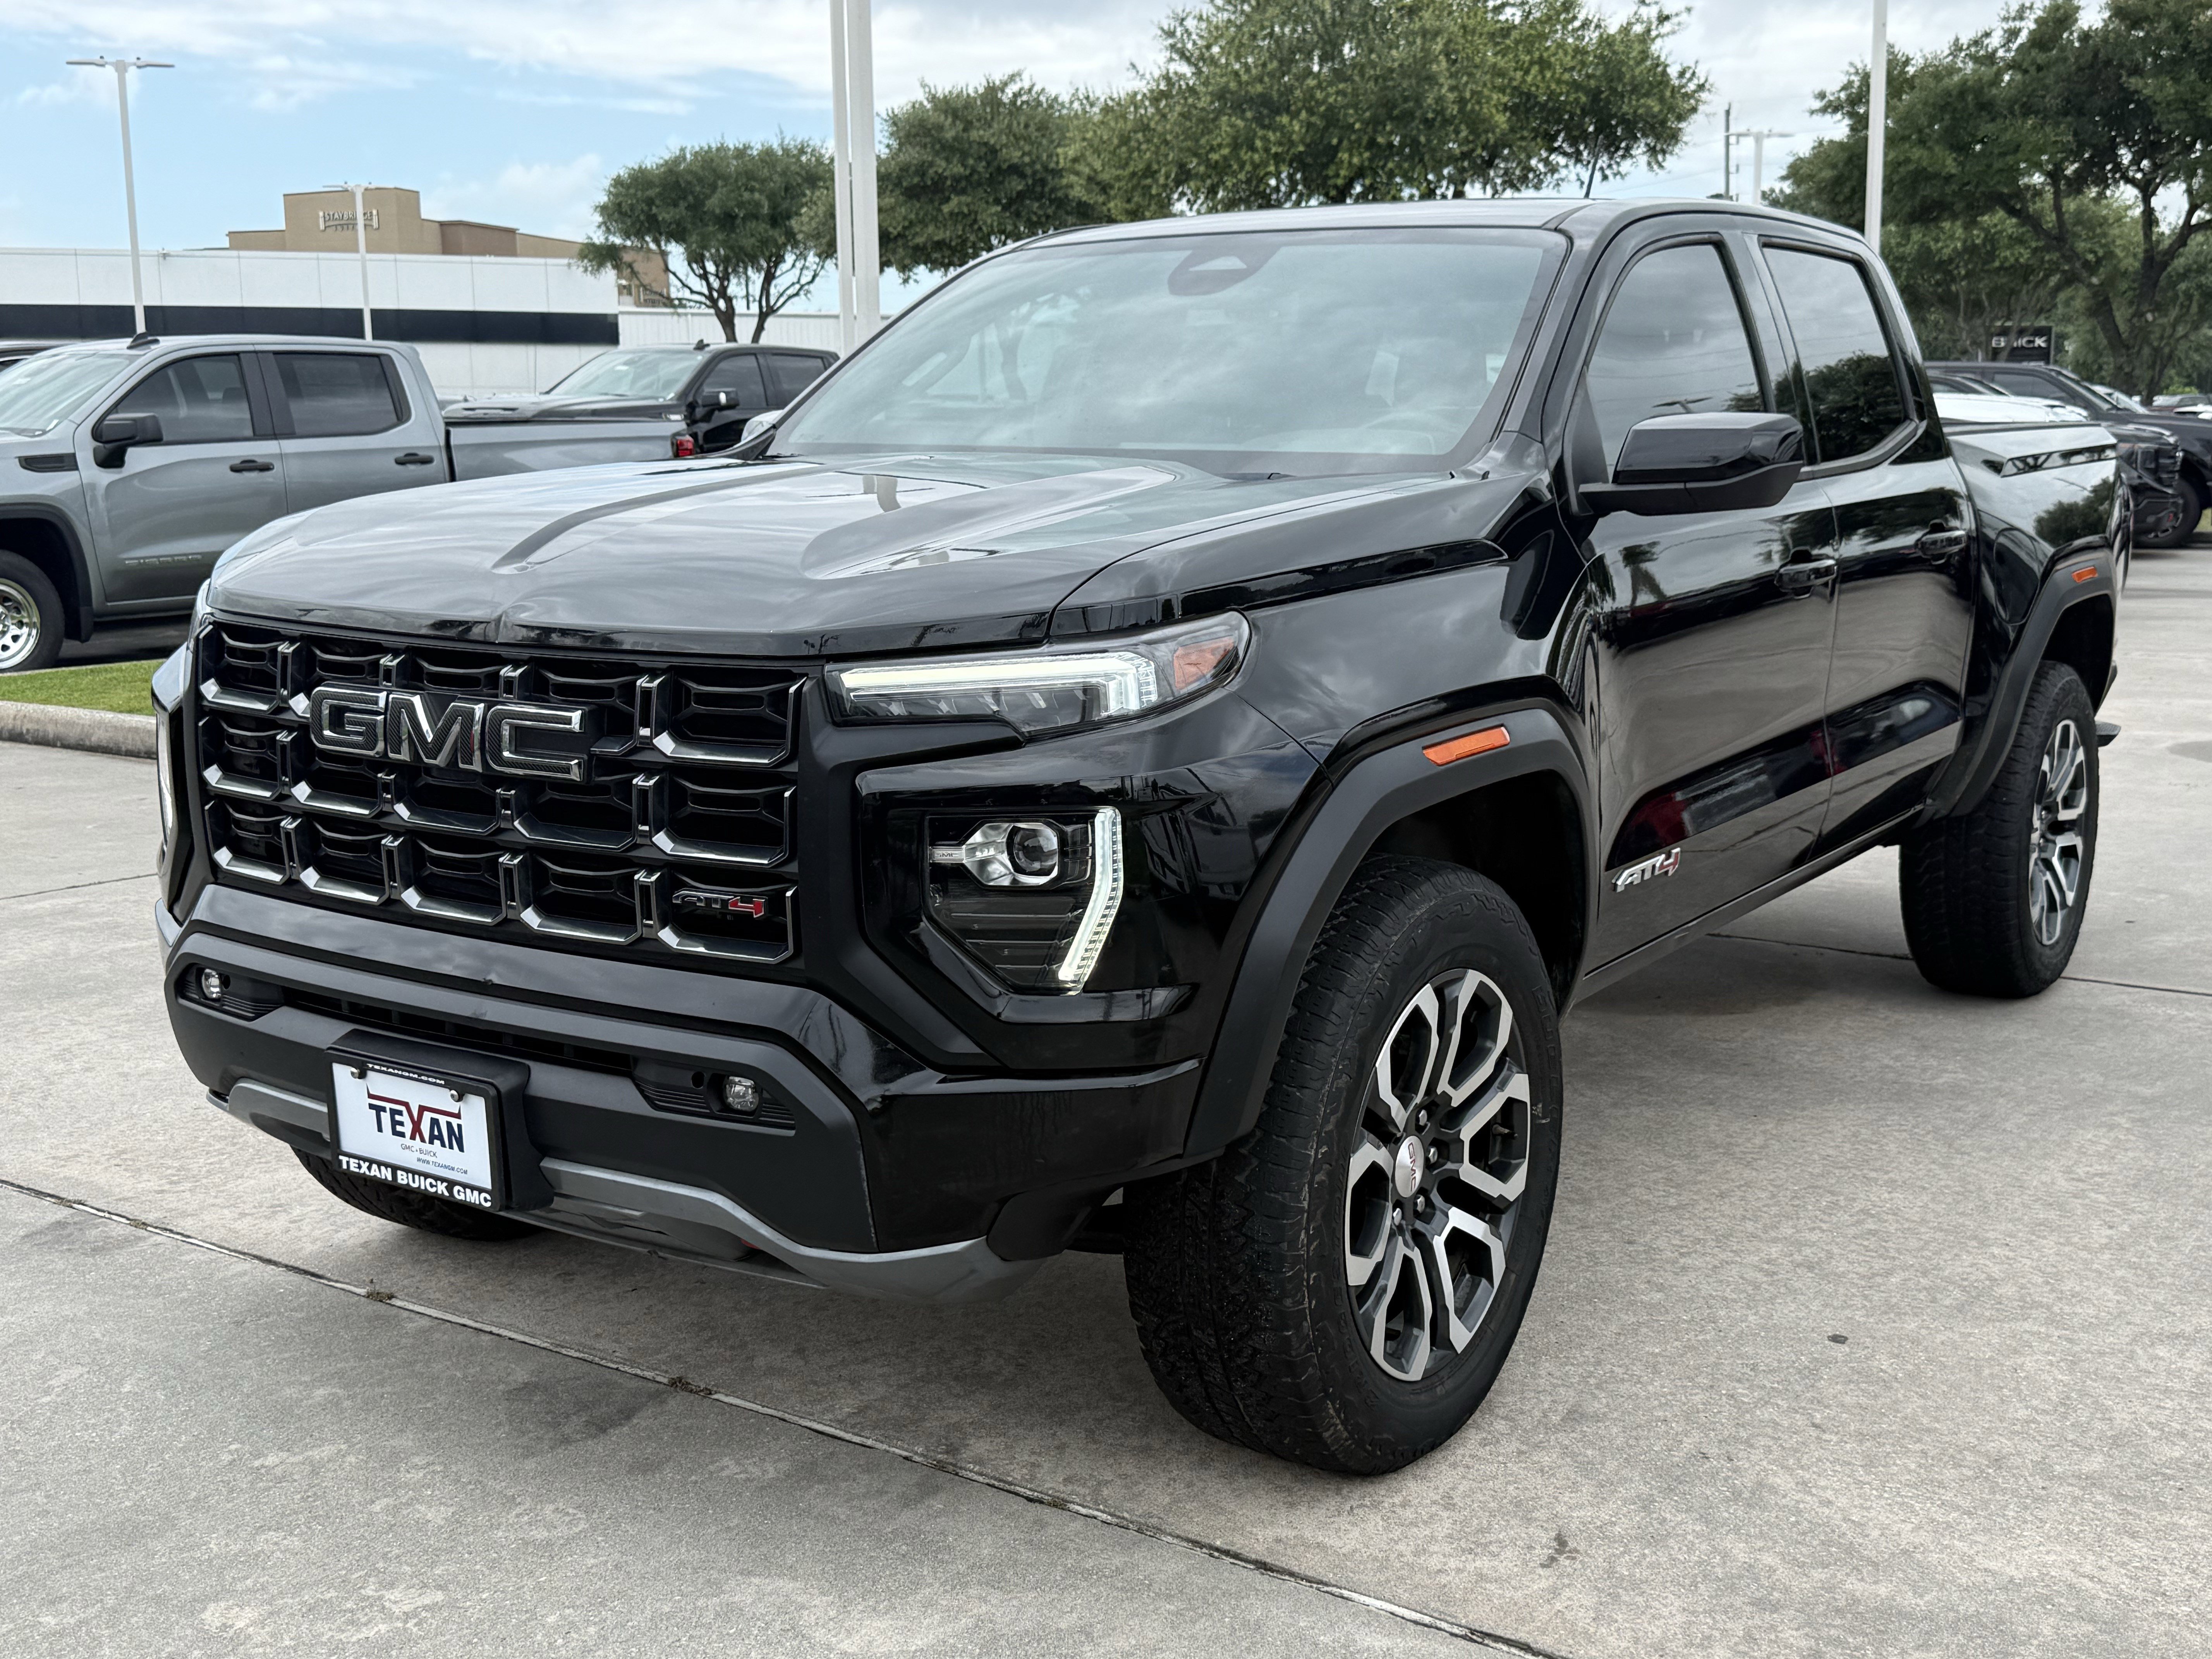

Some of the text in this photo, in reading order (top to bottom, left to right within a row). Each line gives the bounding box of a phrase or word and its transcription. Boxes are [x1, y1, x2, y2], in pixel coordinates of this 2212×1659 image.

[325, 210, 373, 221] STAYBRIGE
[1992, 336, 2048, 348] BICK
[311, 685, 585, 781] GMC
[1616, 847, 1681, 893] AT4
[672, 890, 765, 918] AT4
[367, 1096, 465, 1153] TEXAN
[401, 1144, 437, 1158] GMC BUICK
[1407, 1142, 1416, 1192] GMC
[339, 1155, 492, 1207] TEXAN BUICK GMC
